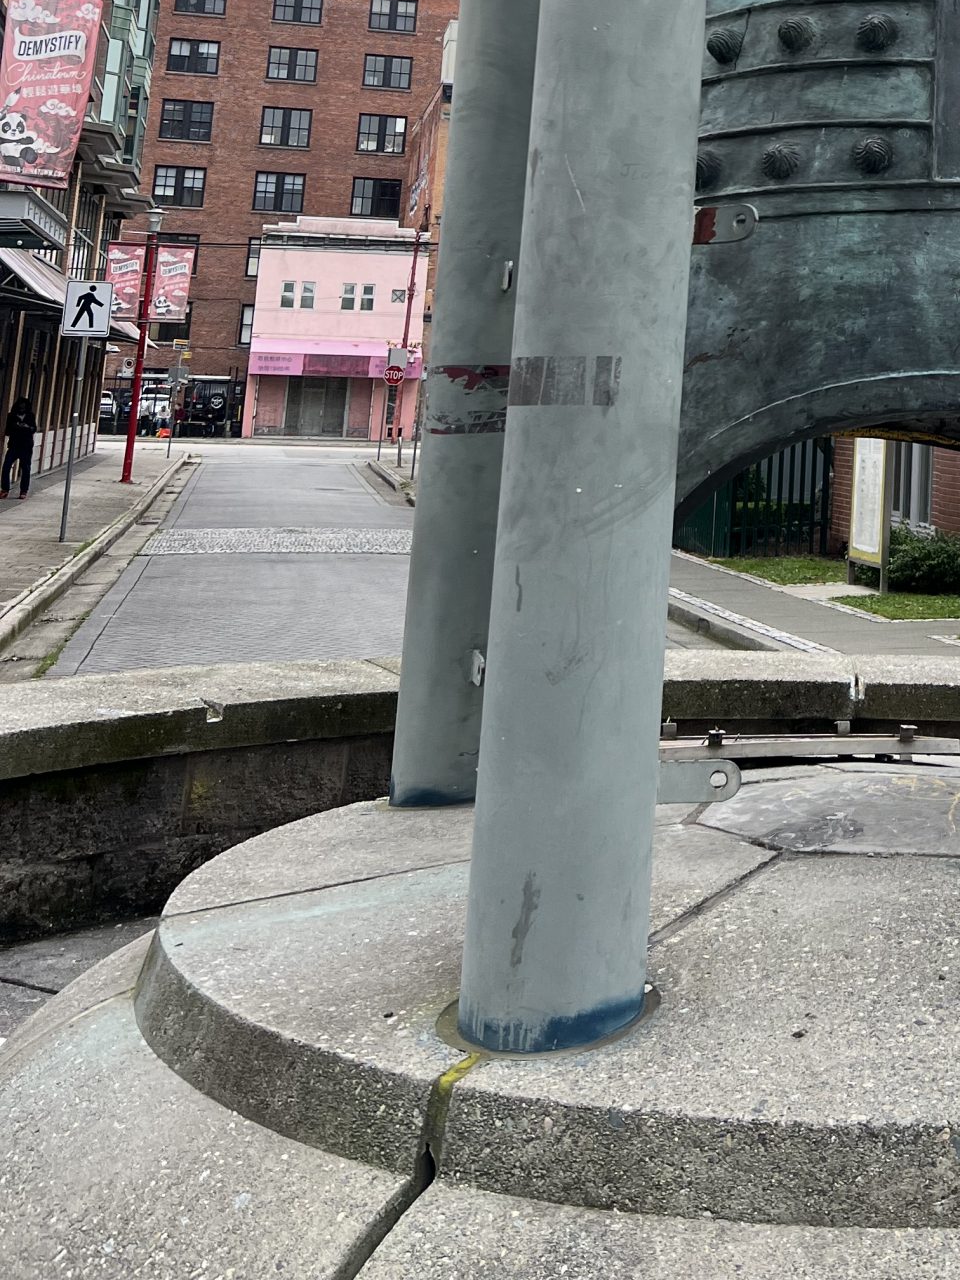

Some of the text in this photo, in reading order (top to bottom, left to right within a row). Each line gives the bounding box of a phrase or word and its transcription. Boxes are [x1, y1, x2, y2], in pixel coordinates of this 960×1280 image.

[18, 35, 81, 56] DEMYSTIFY
[5, 62, 86, 86] Chinatown
[385, 371, 403, 380] STOP
